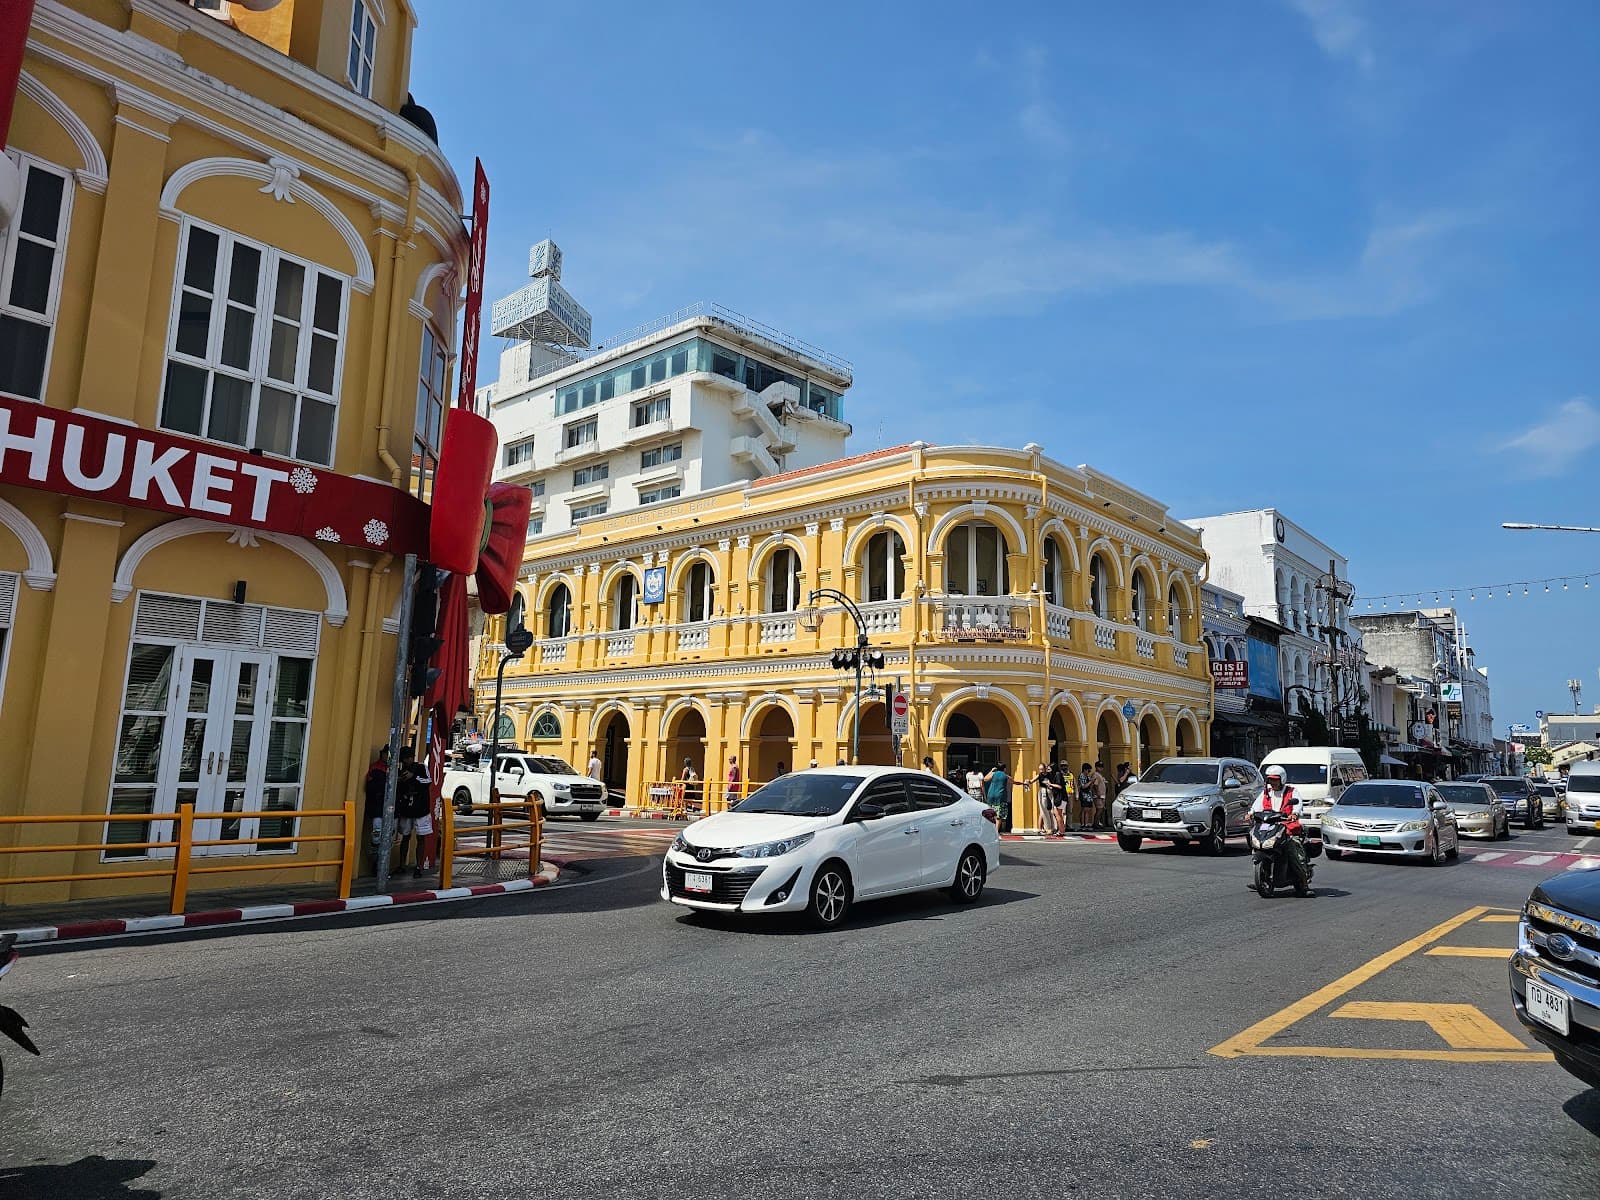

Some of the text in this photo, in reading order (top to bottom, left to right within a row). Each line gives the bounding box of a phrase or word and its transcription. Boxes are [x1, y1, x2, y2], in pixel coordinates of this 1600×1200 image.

[624, 505, 685, 526] CHARTERED
[689, 498, 717, 512] BANK
[1545, 993, 1564, 1014] 4831
